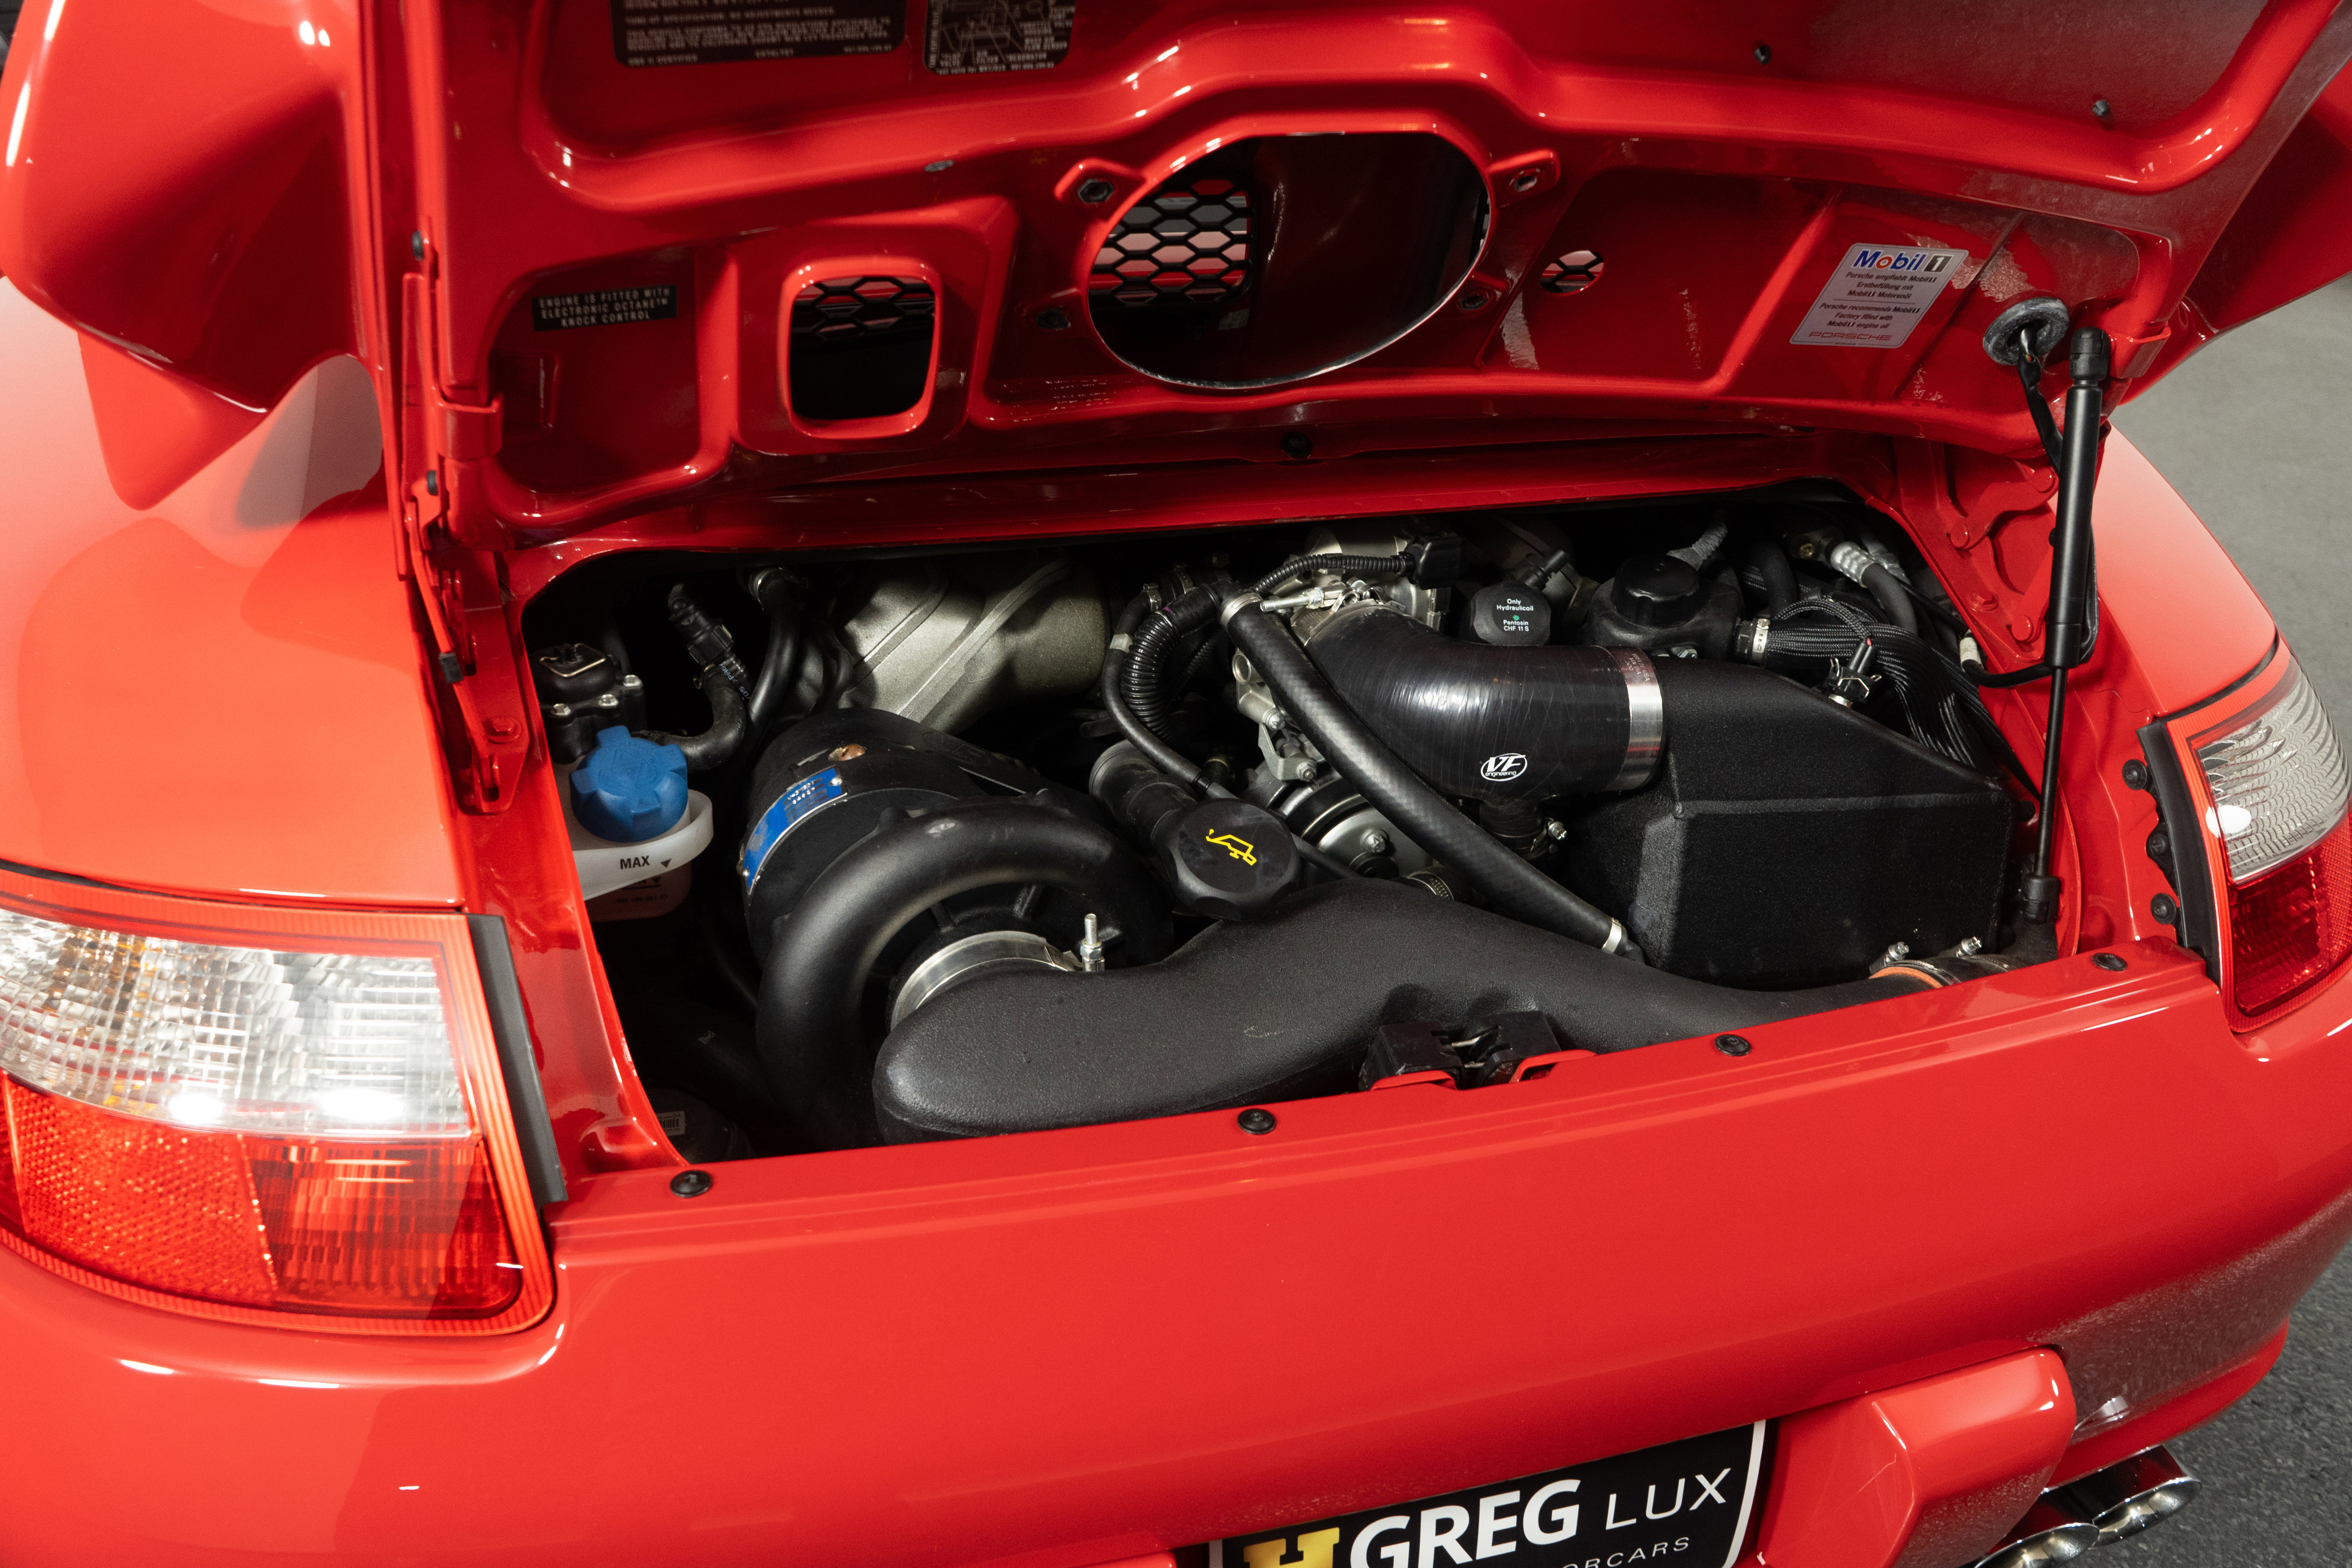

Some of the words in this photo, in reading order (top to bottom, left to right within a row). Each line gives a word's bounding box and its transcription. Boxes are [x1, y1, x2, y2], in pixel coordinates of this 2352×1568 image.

[1852, 250, 1927, 271] Mobil
[1857, 282, 1900, 291] Erstbefüllung
[539, 295, 580, 309] ENGINE
[585, 293, 596, 303] IS
[601, 290, 639, 303] FITTED
[644, 287, 670, 298] WITH
[541, 304, 609, 320] ELECTRONIC
[561, 317, 597, 327] KNOCK
[601, 310, 651, 324] CONTROL
[1809, 332, 1893, 341] PORSCHE
[1487, 755, 1526, 772] VF
[620, 855, 650, 870] MAX
[1606, 1468, 1731, 1530] LUX
